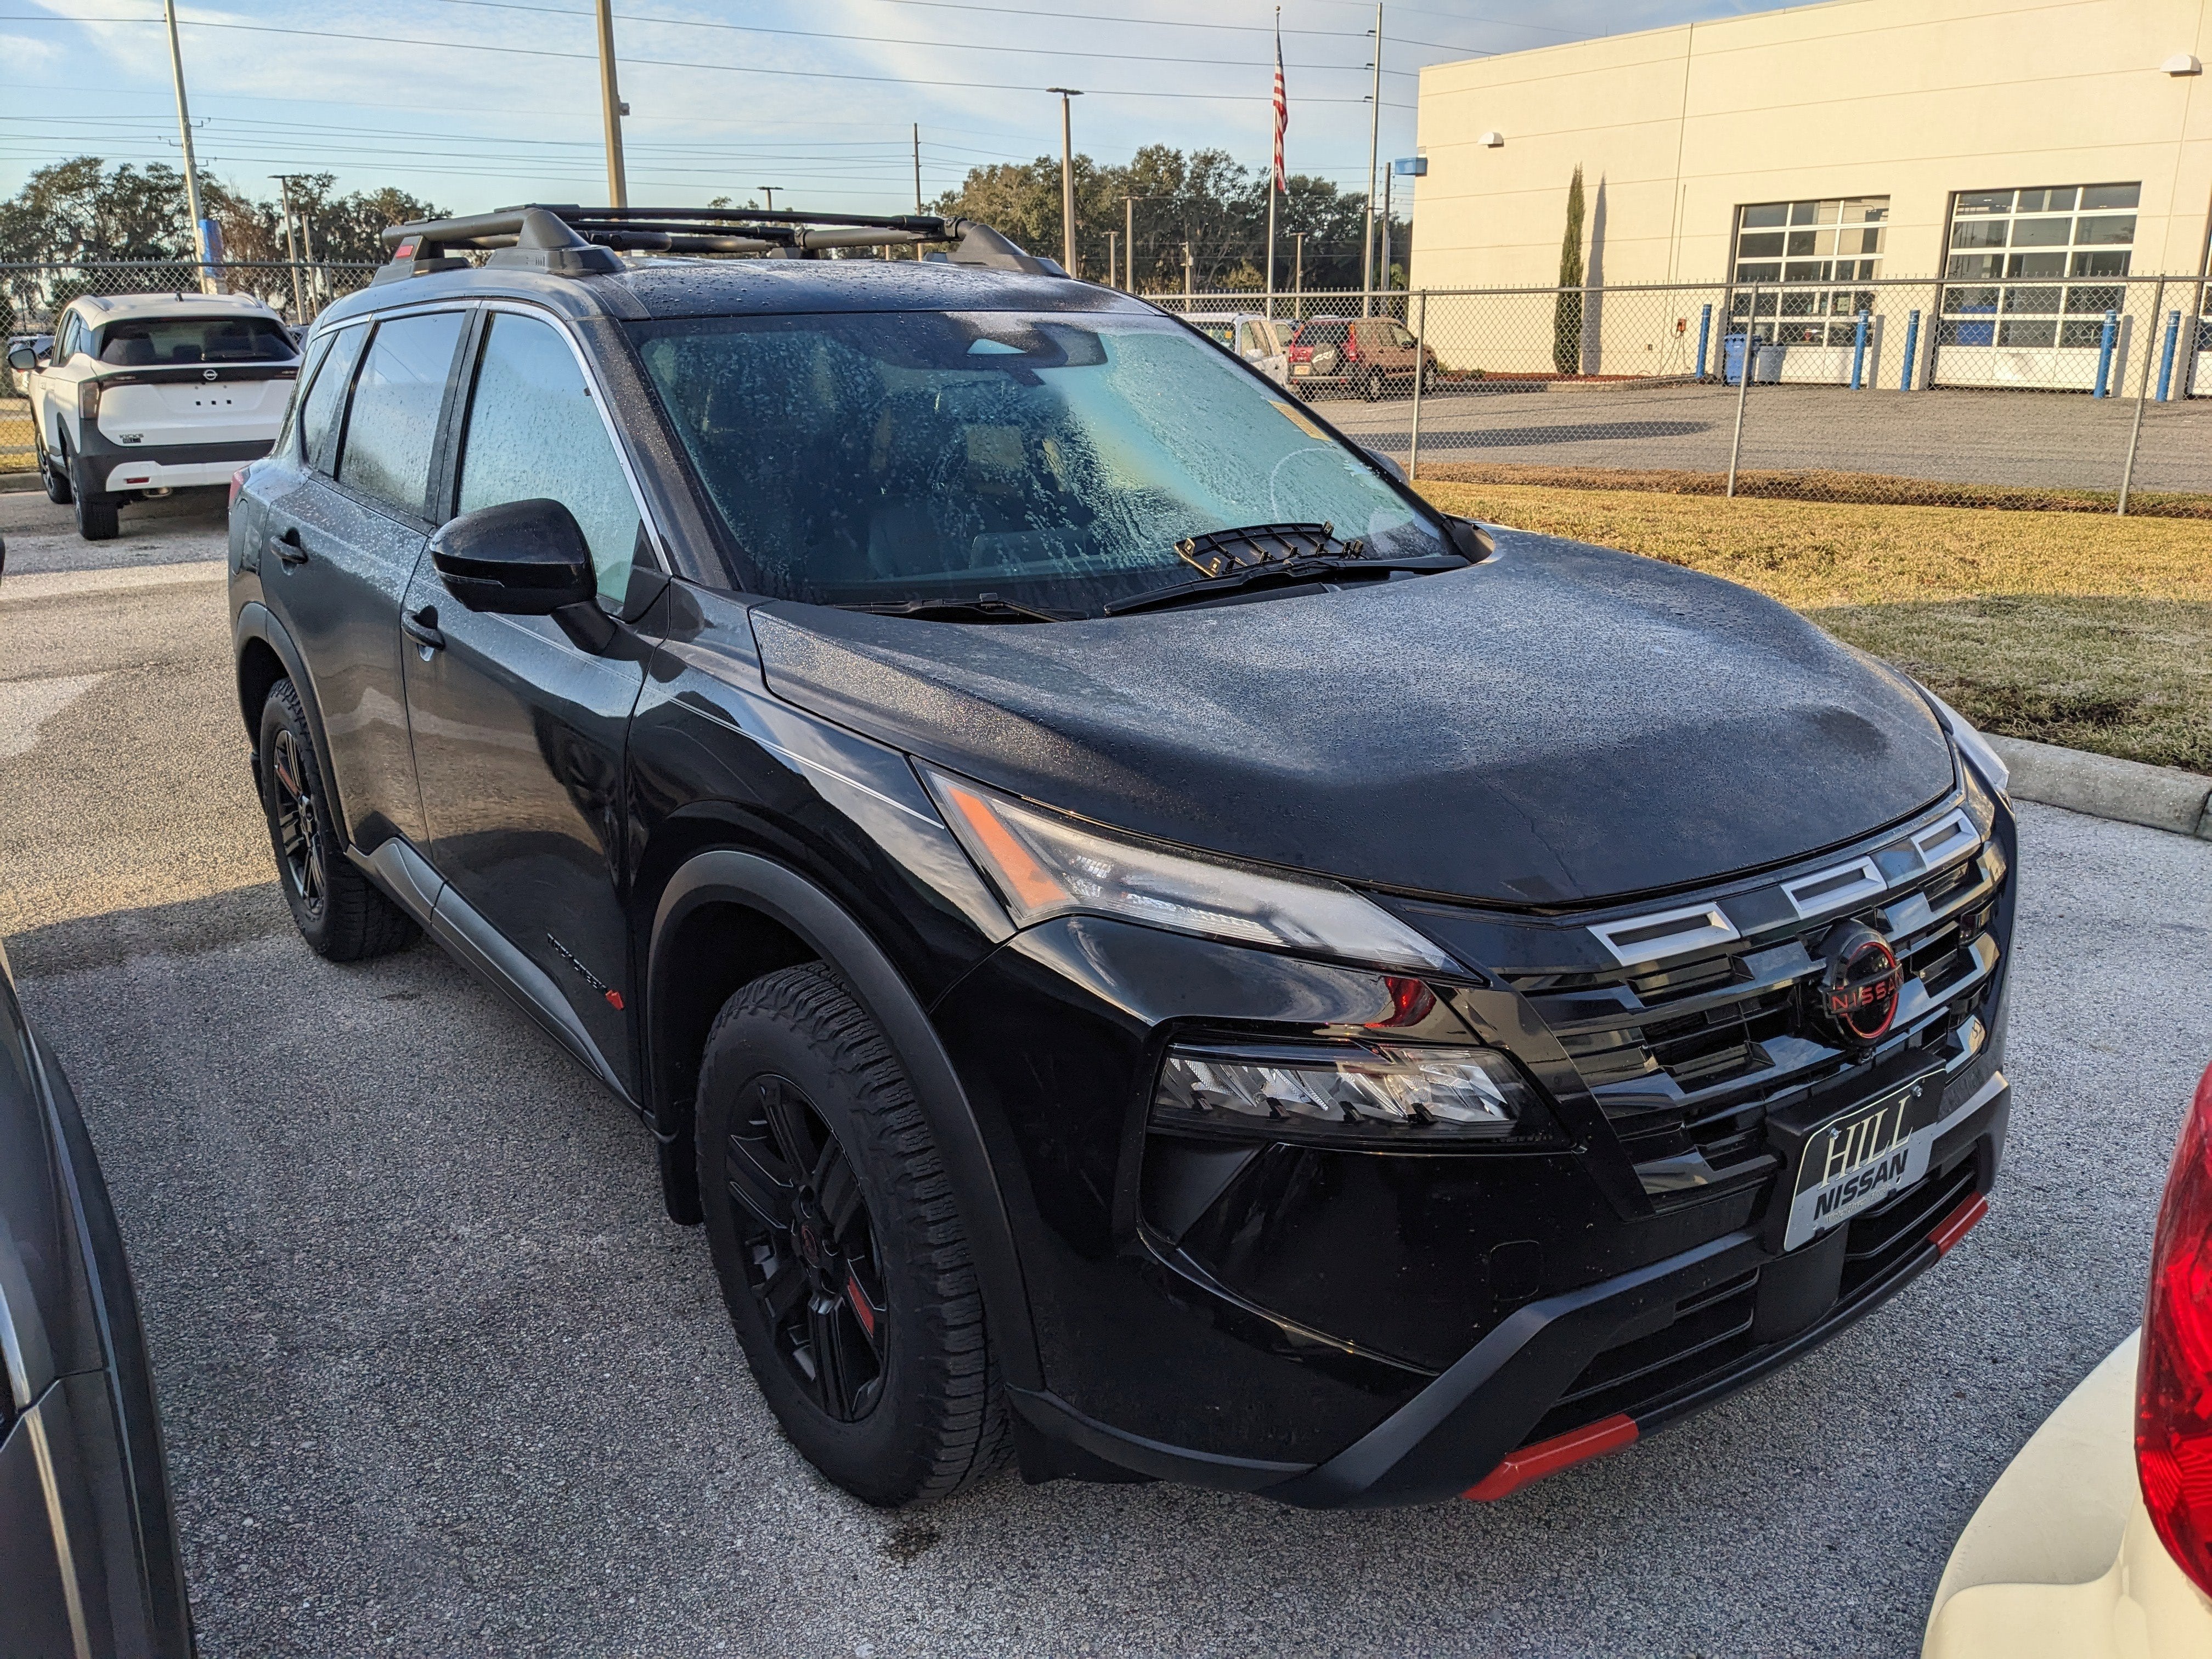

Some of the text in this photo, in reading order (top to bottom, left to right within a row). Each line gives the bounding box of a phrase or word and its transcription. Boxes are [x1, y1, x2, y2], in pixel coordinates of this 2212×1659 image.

[1832, 969, 1903, 1010] NISSAN
[1818, 1094, 1913, 1190] HILL
[1814, 1149, 1909, 1220] NISSAN
